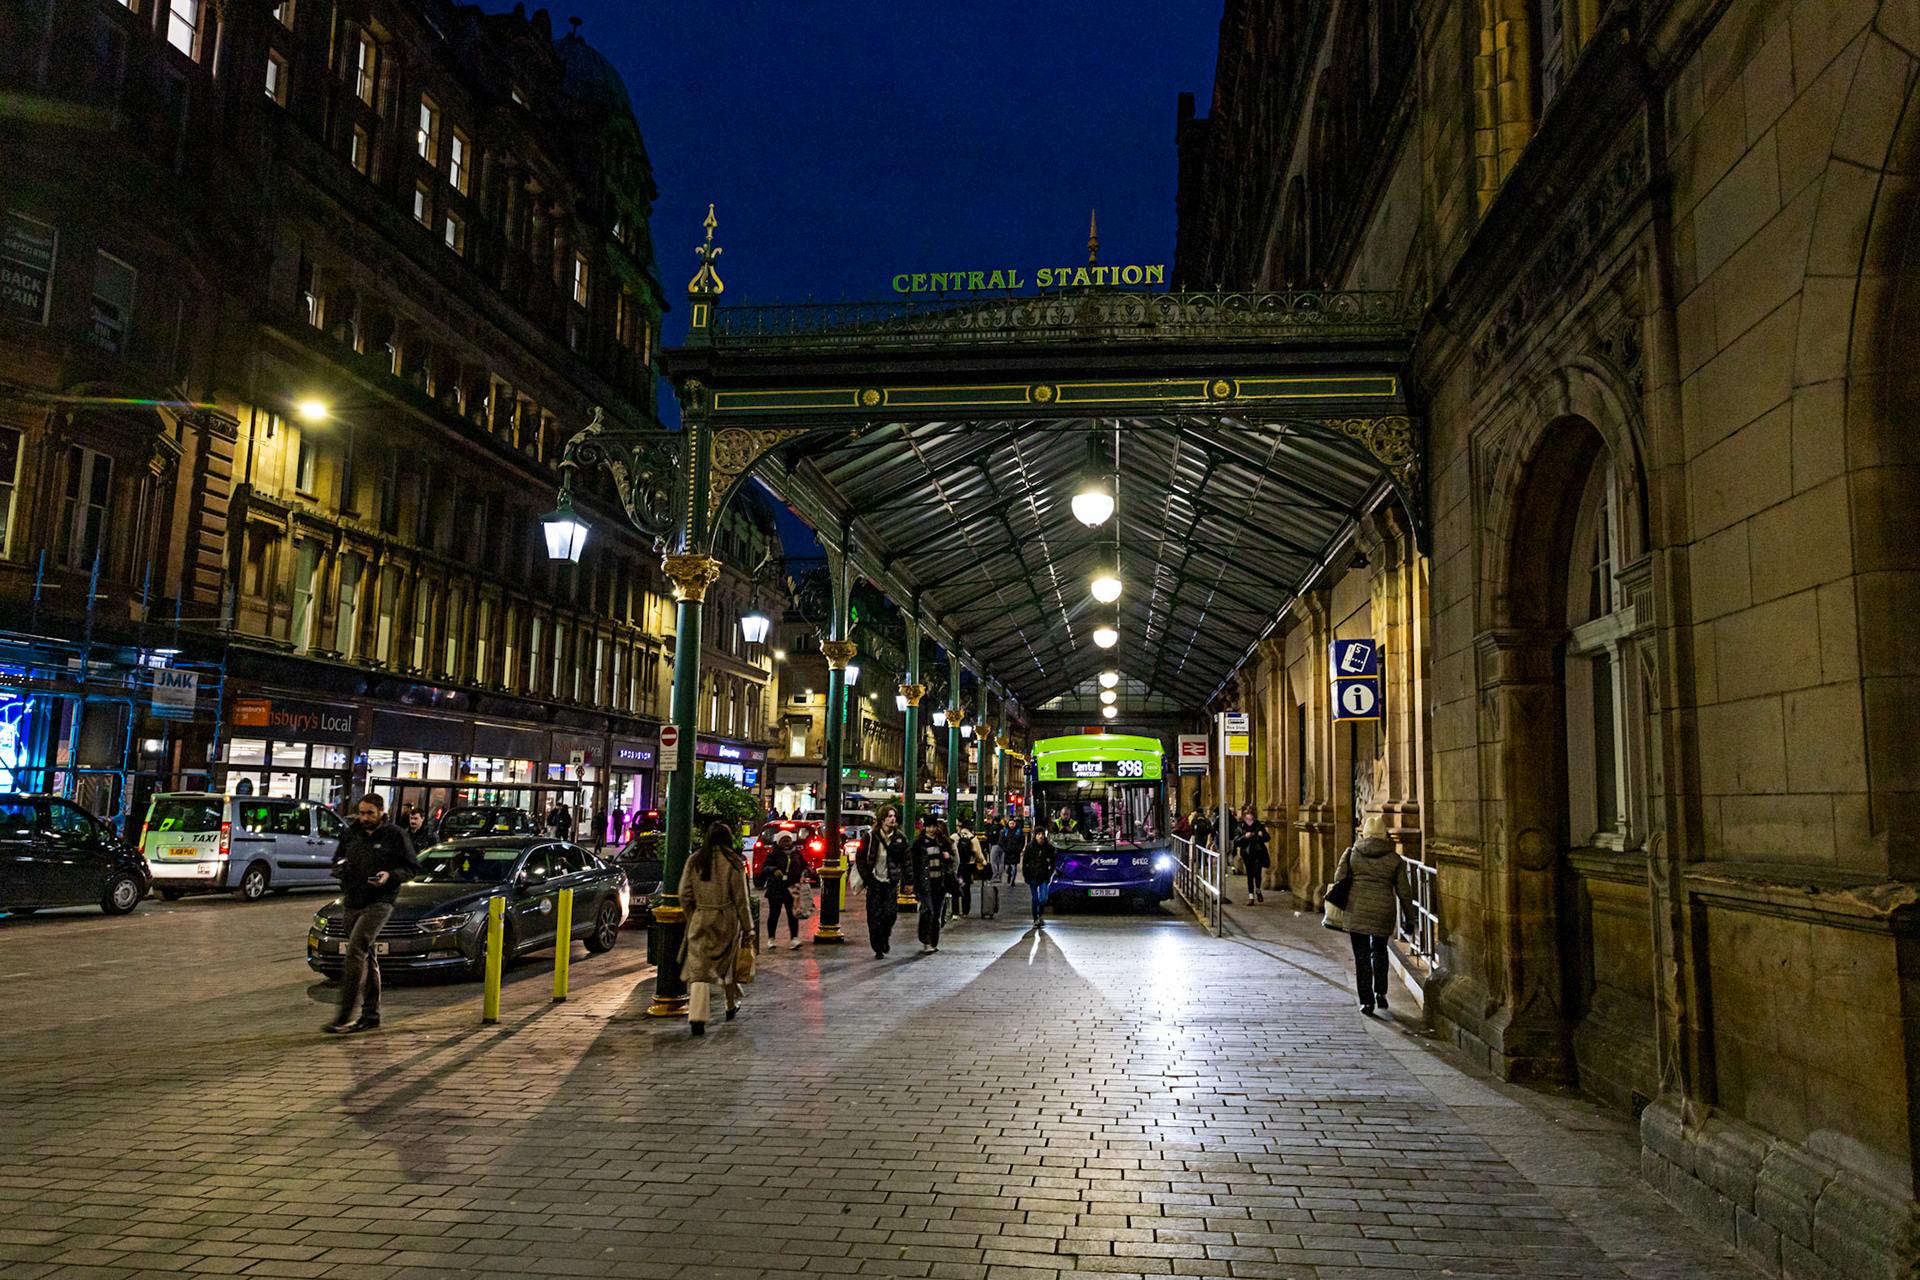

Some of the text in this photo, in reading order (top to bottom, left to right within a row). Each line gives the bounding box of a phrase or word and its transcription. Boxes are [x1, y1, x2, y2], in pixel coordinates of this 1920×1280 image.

[1, 269, 42, 293] BACK
[892, 264, 1164, 293] CENTRAL STATION
[2, 286, 39, 308] PAIN
[158, 671, 193, 689] JMK
[269, 708, 352, 732] nsbury's Local
[1072, 761, 1102, 773] Central
[1117, 760, 1143, 777] 398
[193, 834, 218, 842] TAXI
